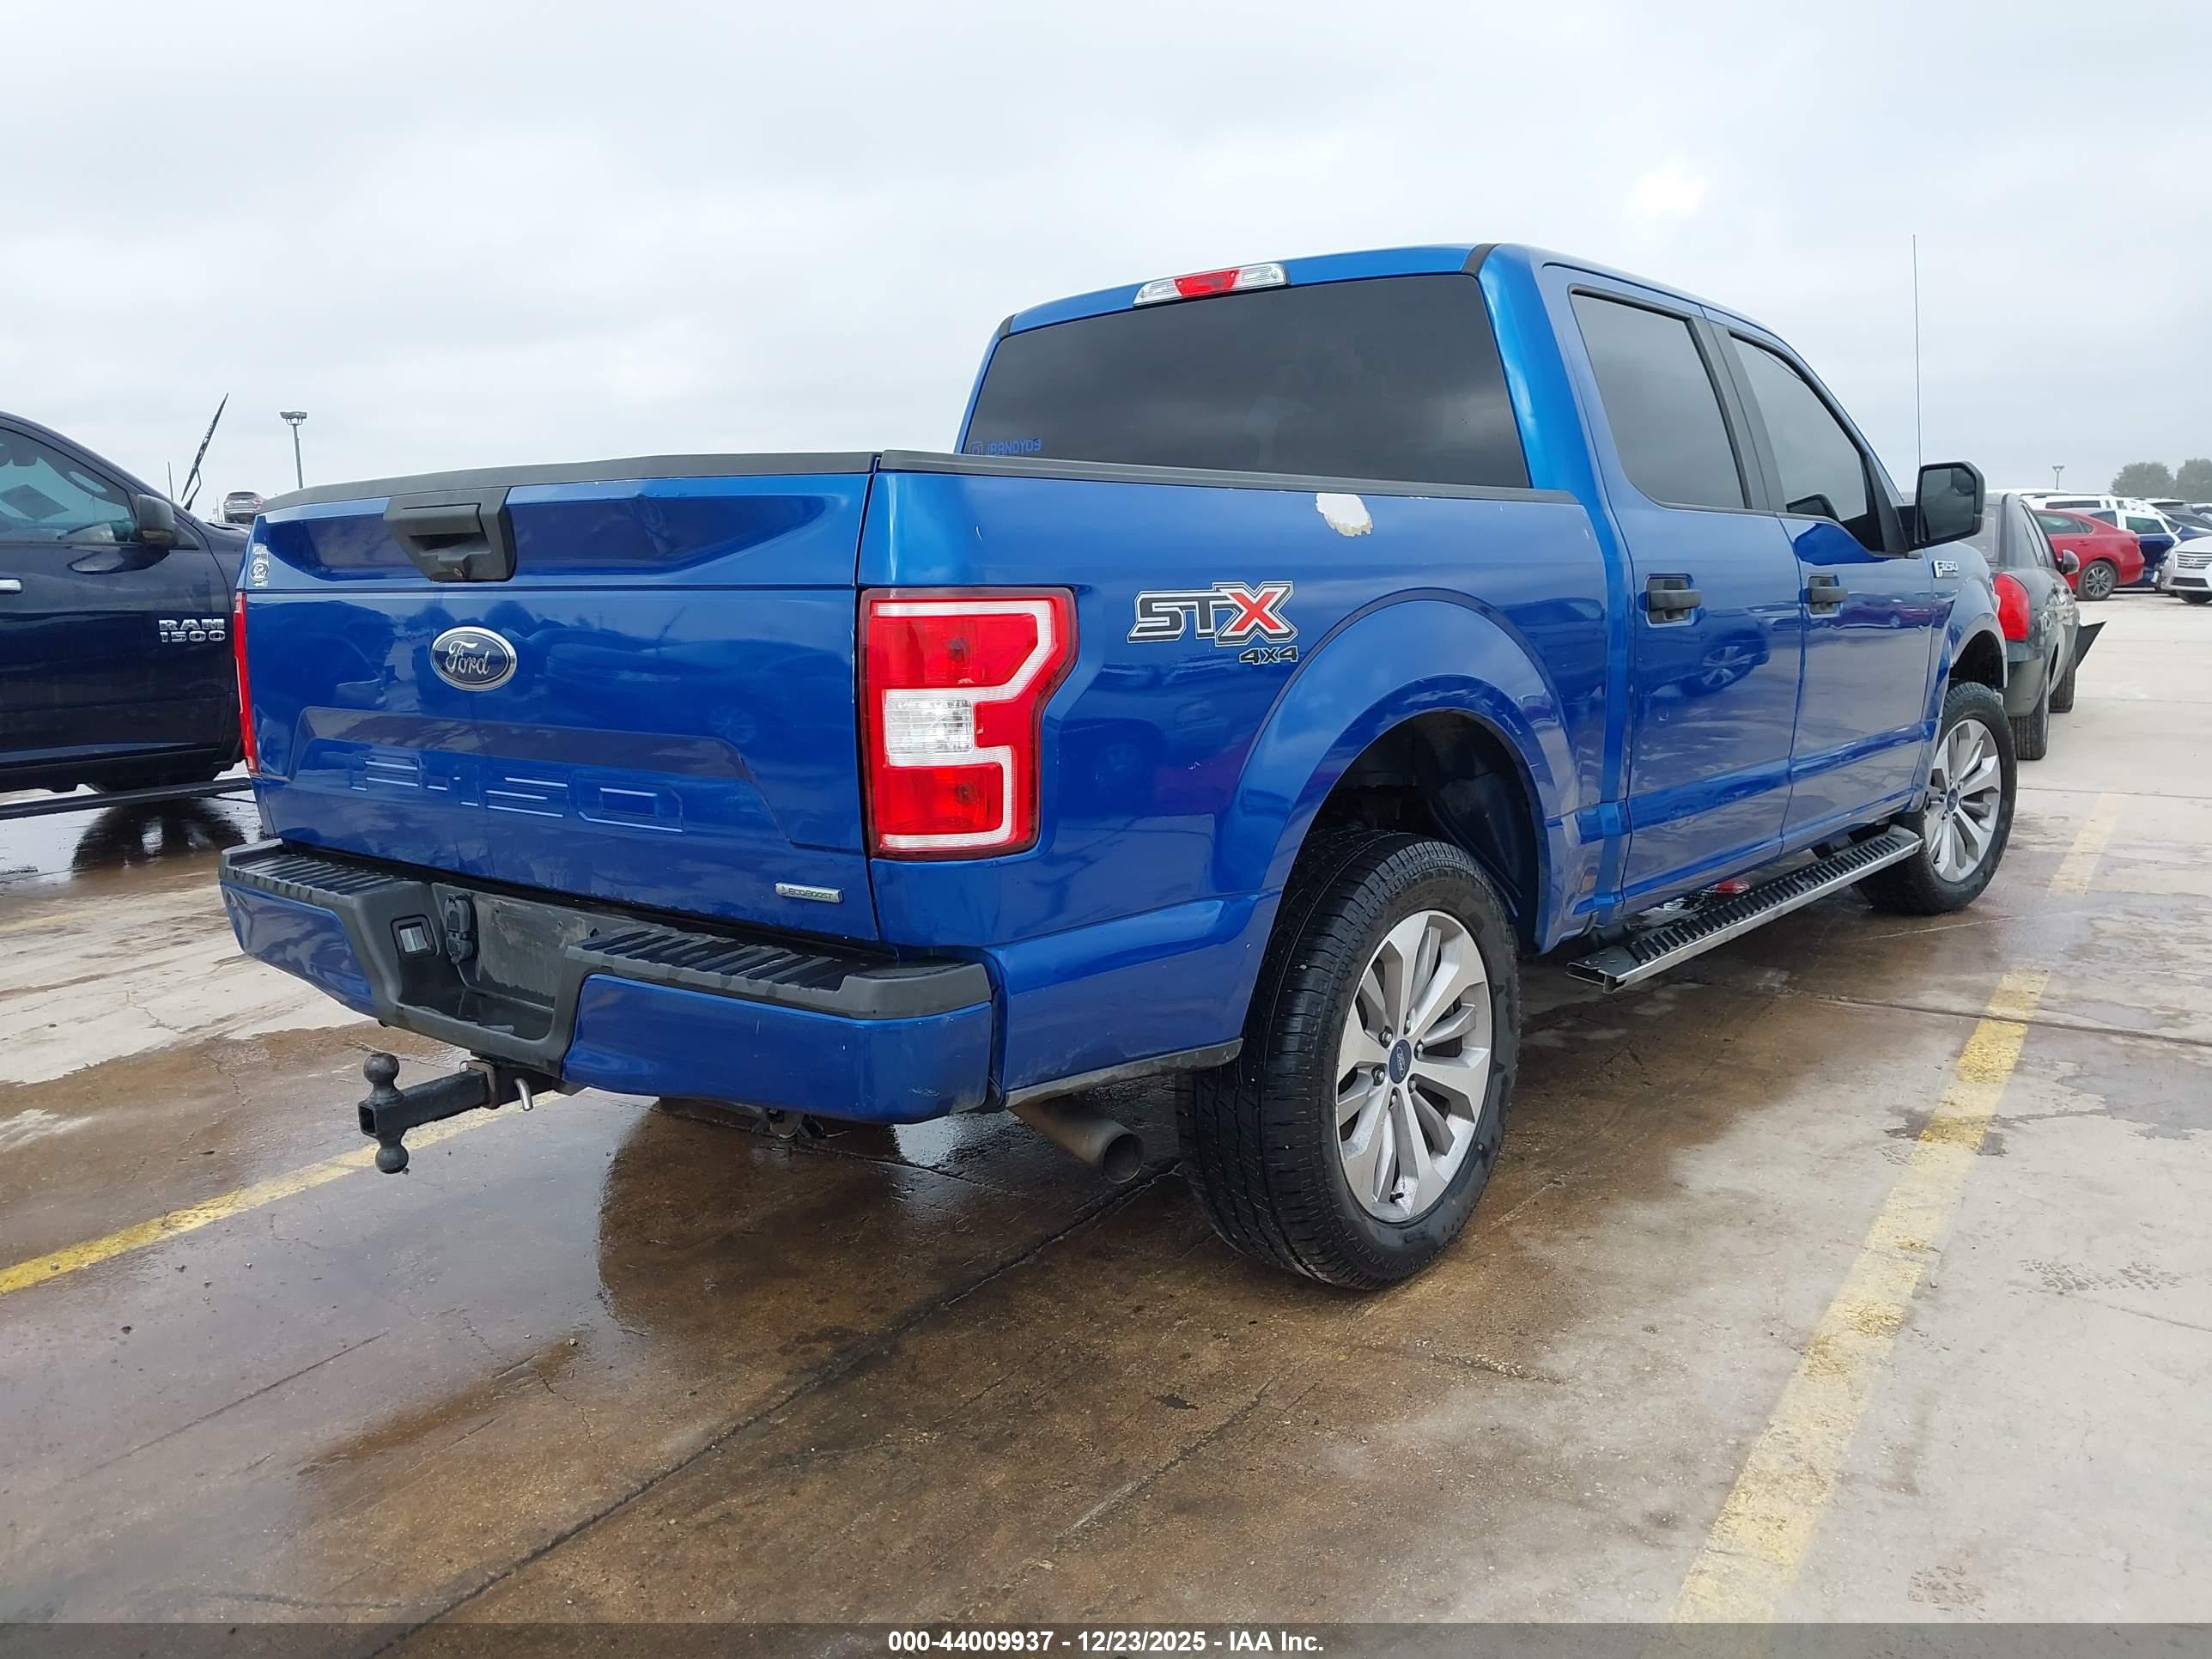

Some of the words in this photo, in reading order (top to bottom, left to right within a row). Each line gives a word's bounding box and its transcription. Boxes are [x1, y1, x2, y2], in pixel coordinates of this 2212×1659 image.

[158, 619, 225, 630] RAM
[1127, 581, 1298, 647] STX
[160, 630, 226, 642] 1500
[445, 640, 490, 674] Ford
